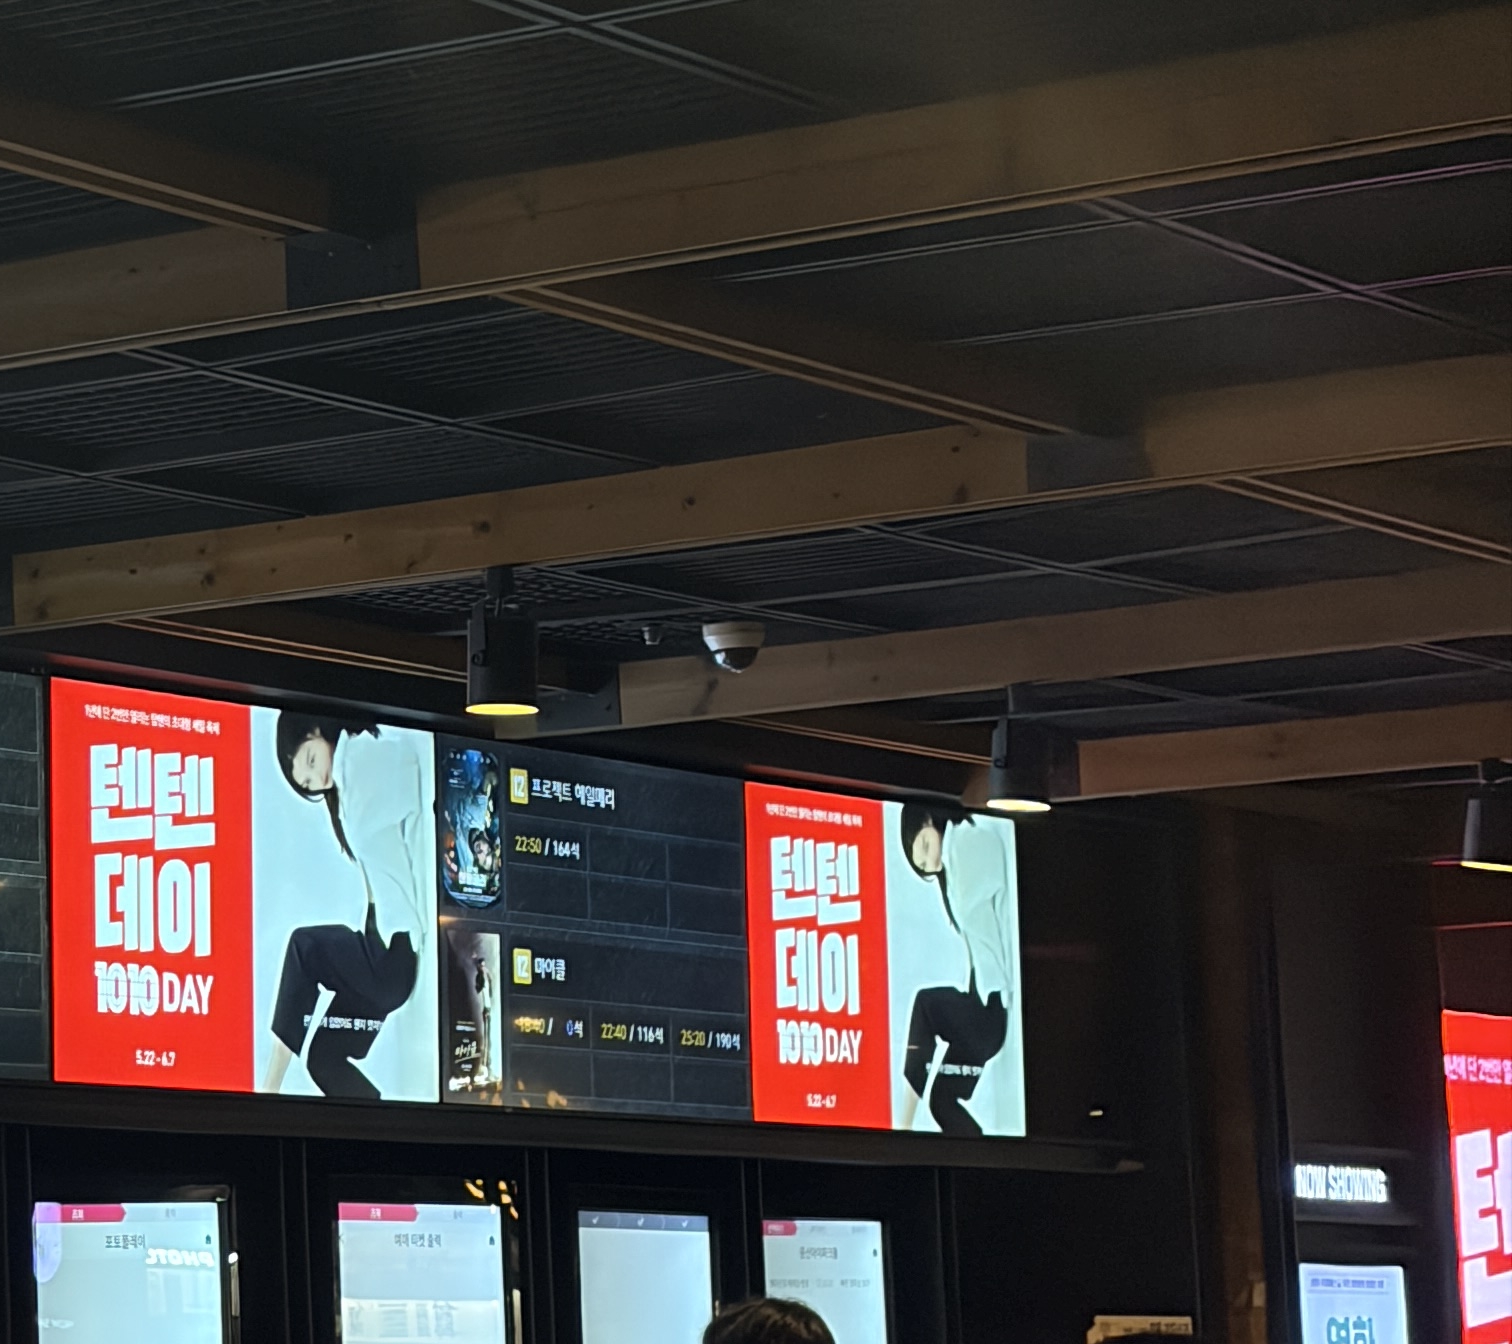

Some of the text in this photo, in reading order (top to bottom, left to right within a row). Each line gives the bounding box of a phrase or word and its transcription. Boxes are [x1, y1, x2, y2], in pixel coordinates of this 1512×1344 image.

[90, 743, 215, 850] 텐텐
[531, 778, 573, 803] 프로젝트
[515, 835, 542, 854] 22:50
[552, 840, 580, 860] 164석
[770, 835, 861, 926] 텐텐
[94, 853, 211, 957] 데이
[534, 958, 566, 981] 마이클
[775, 927, 860, 1015] 데이
[601, 1023, 627, 1040] 22:40
[1294, 1164, 1387, 1203] NOW SHOWING
